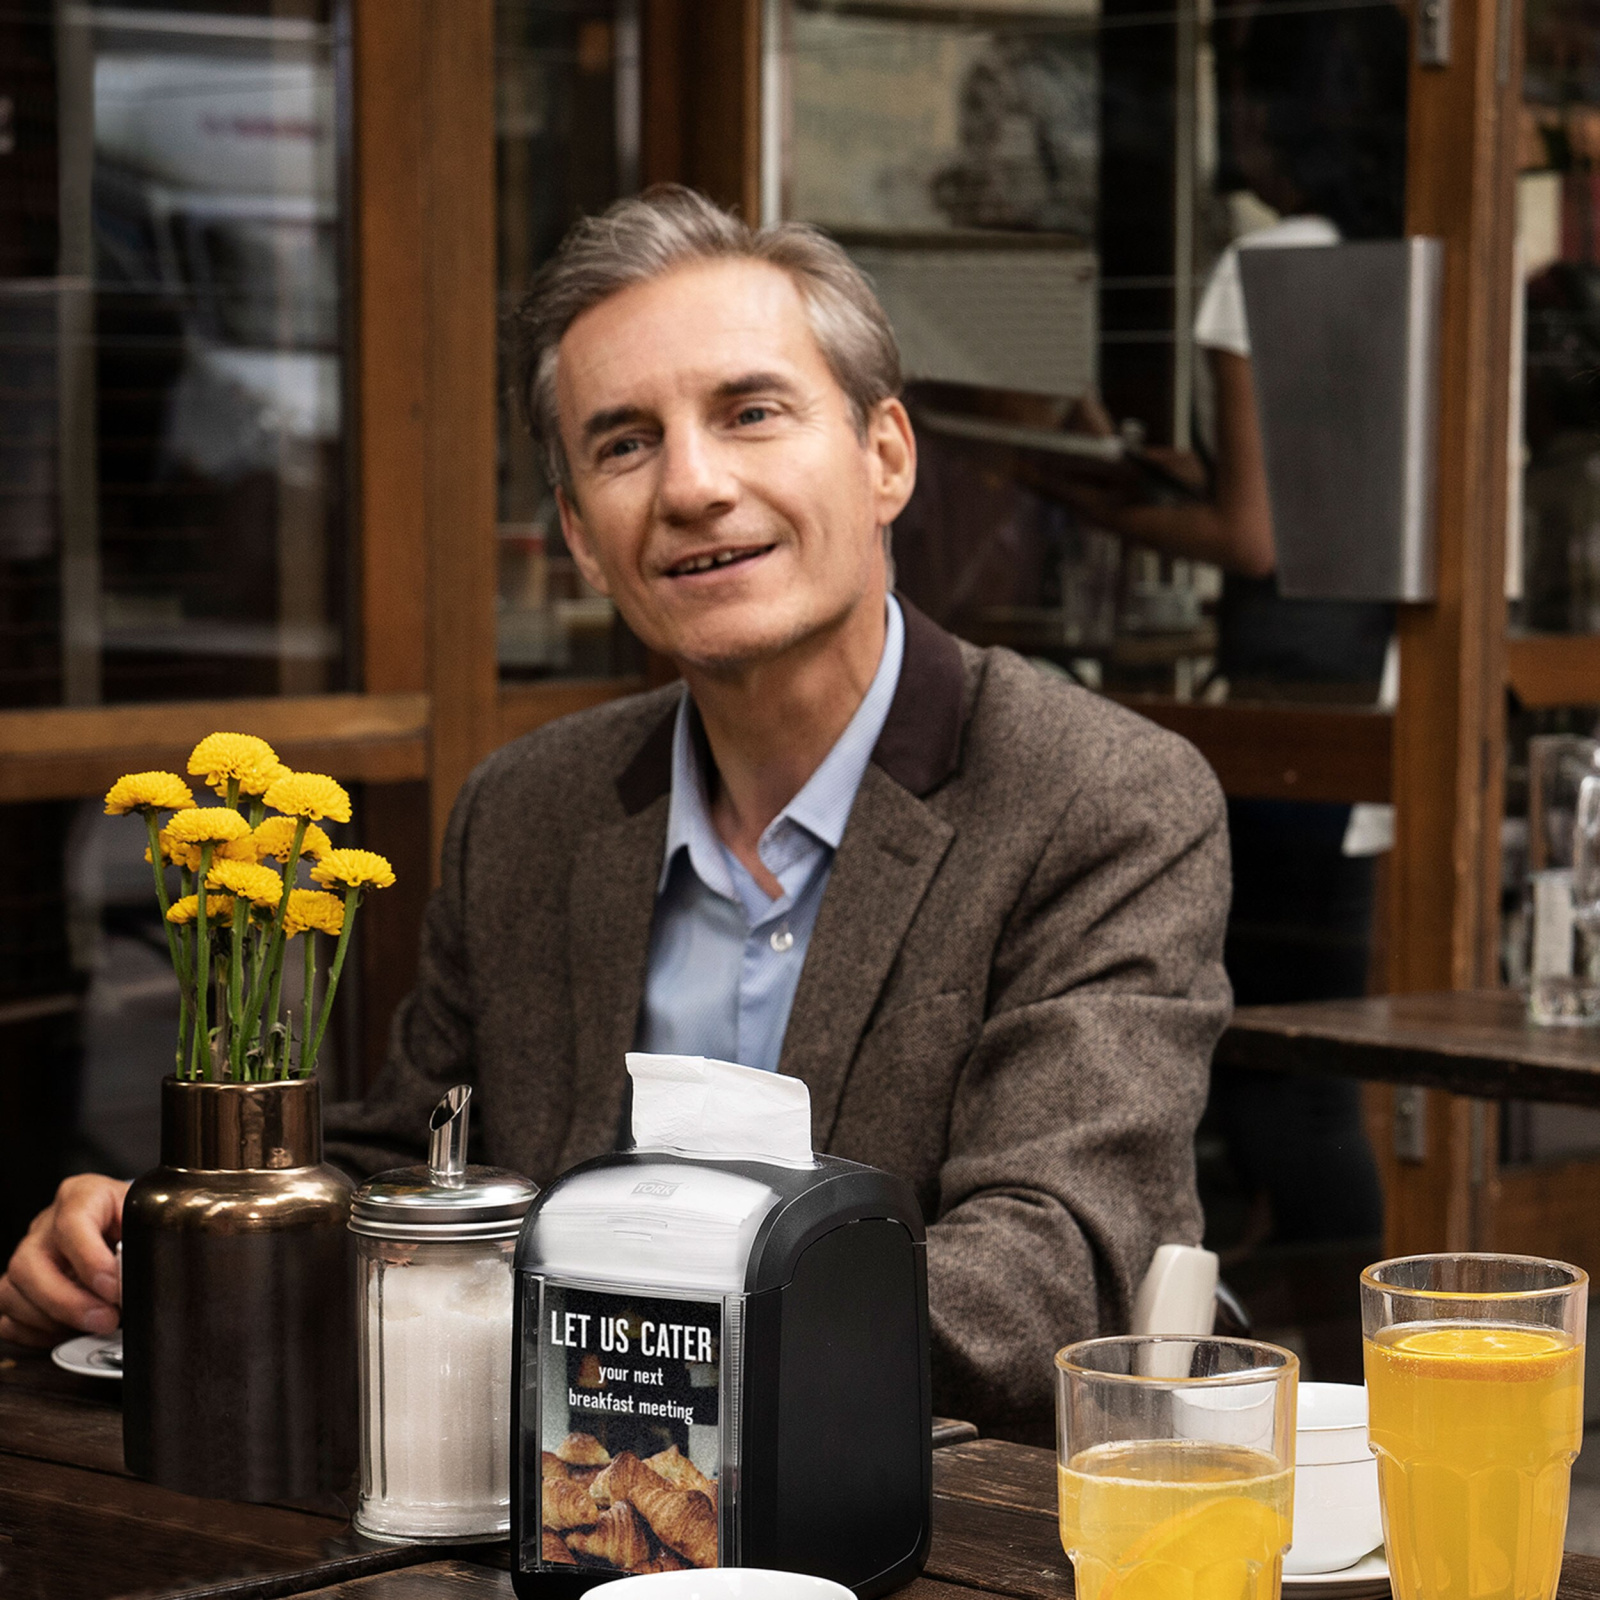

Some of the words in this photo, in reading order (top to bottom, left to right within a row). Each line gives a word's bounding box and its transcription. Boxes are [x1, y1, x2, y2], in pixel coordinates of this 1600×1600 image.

[634, 1183, 676, 1196] TORK
[551, 1310, 591, 1349] LET
[600, 1317, 629, 1354] US
[641, 1321, 712, 1363] CATER
[598, 1366, 629, 1384] your
[634, 1368, 664, 1386] next
[568, 1388, 634, 1413] breakfast
[639, 1400, 694, 1425] meeting
